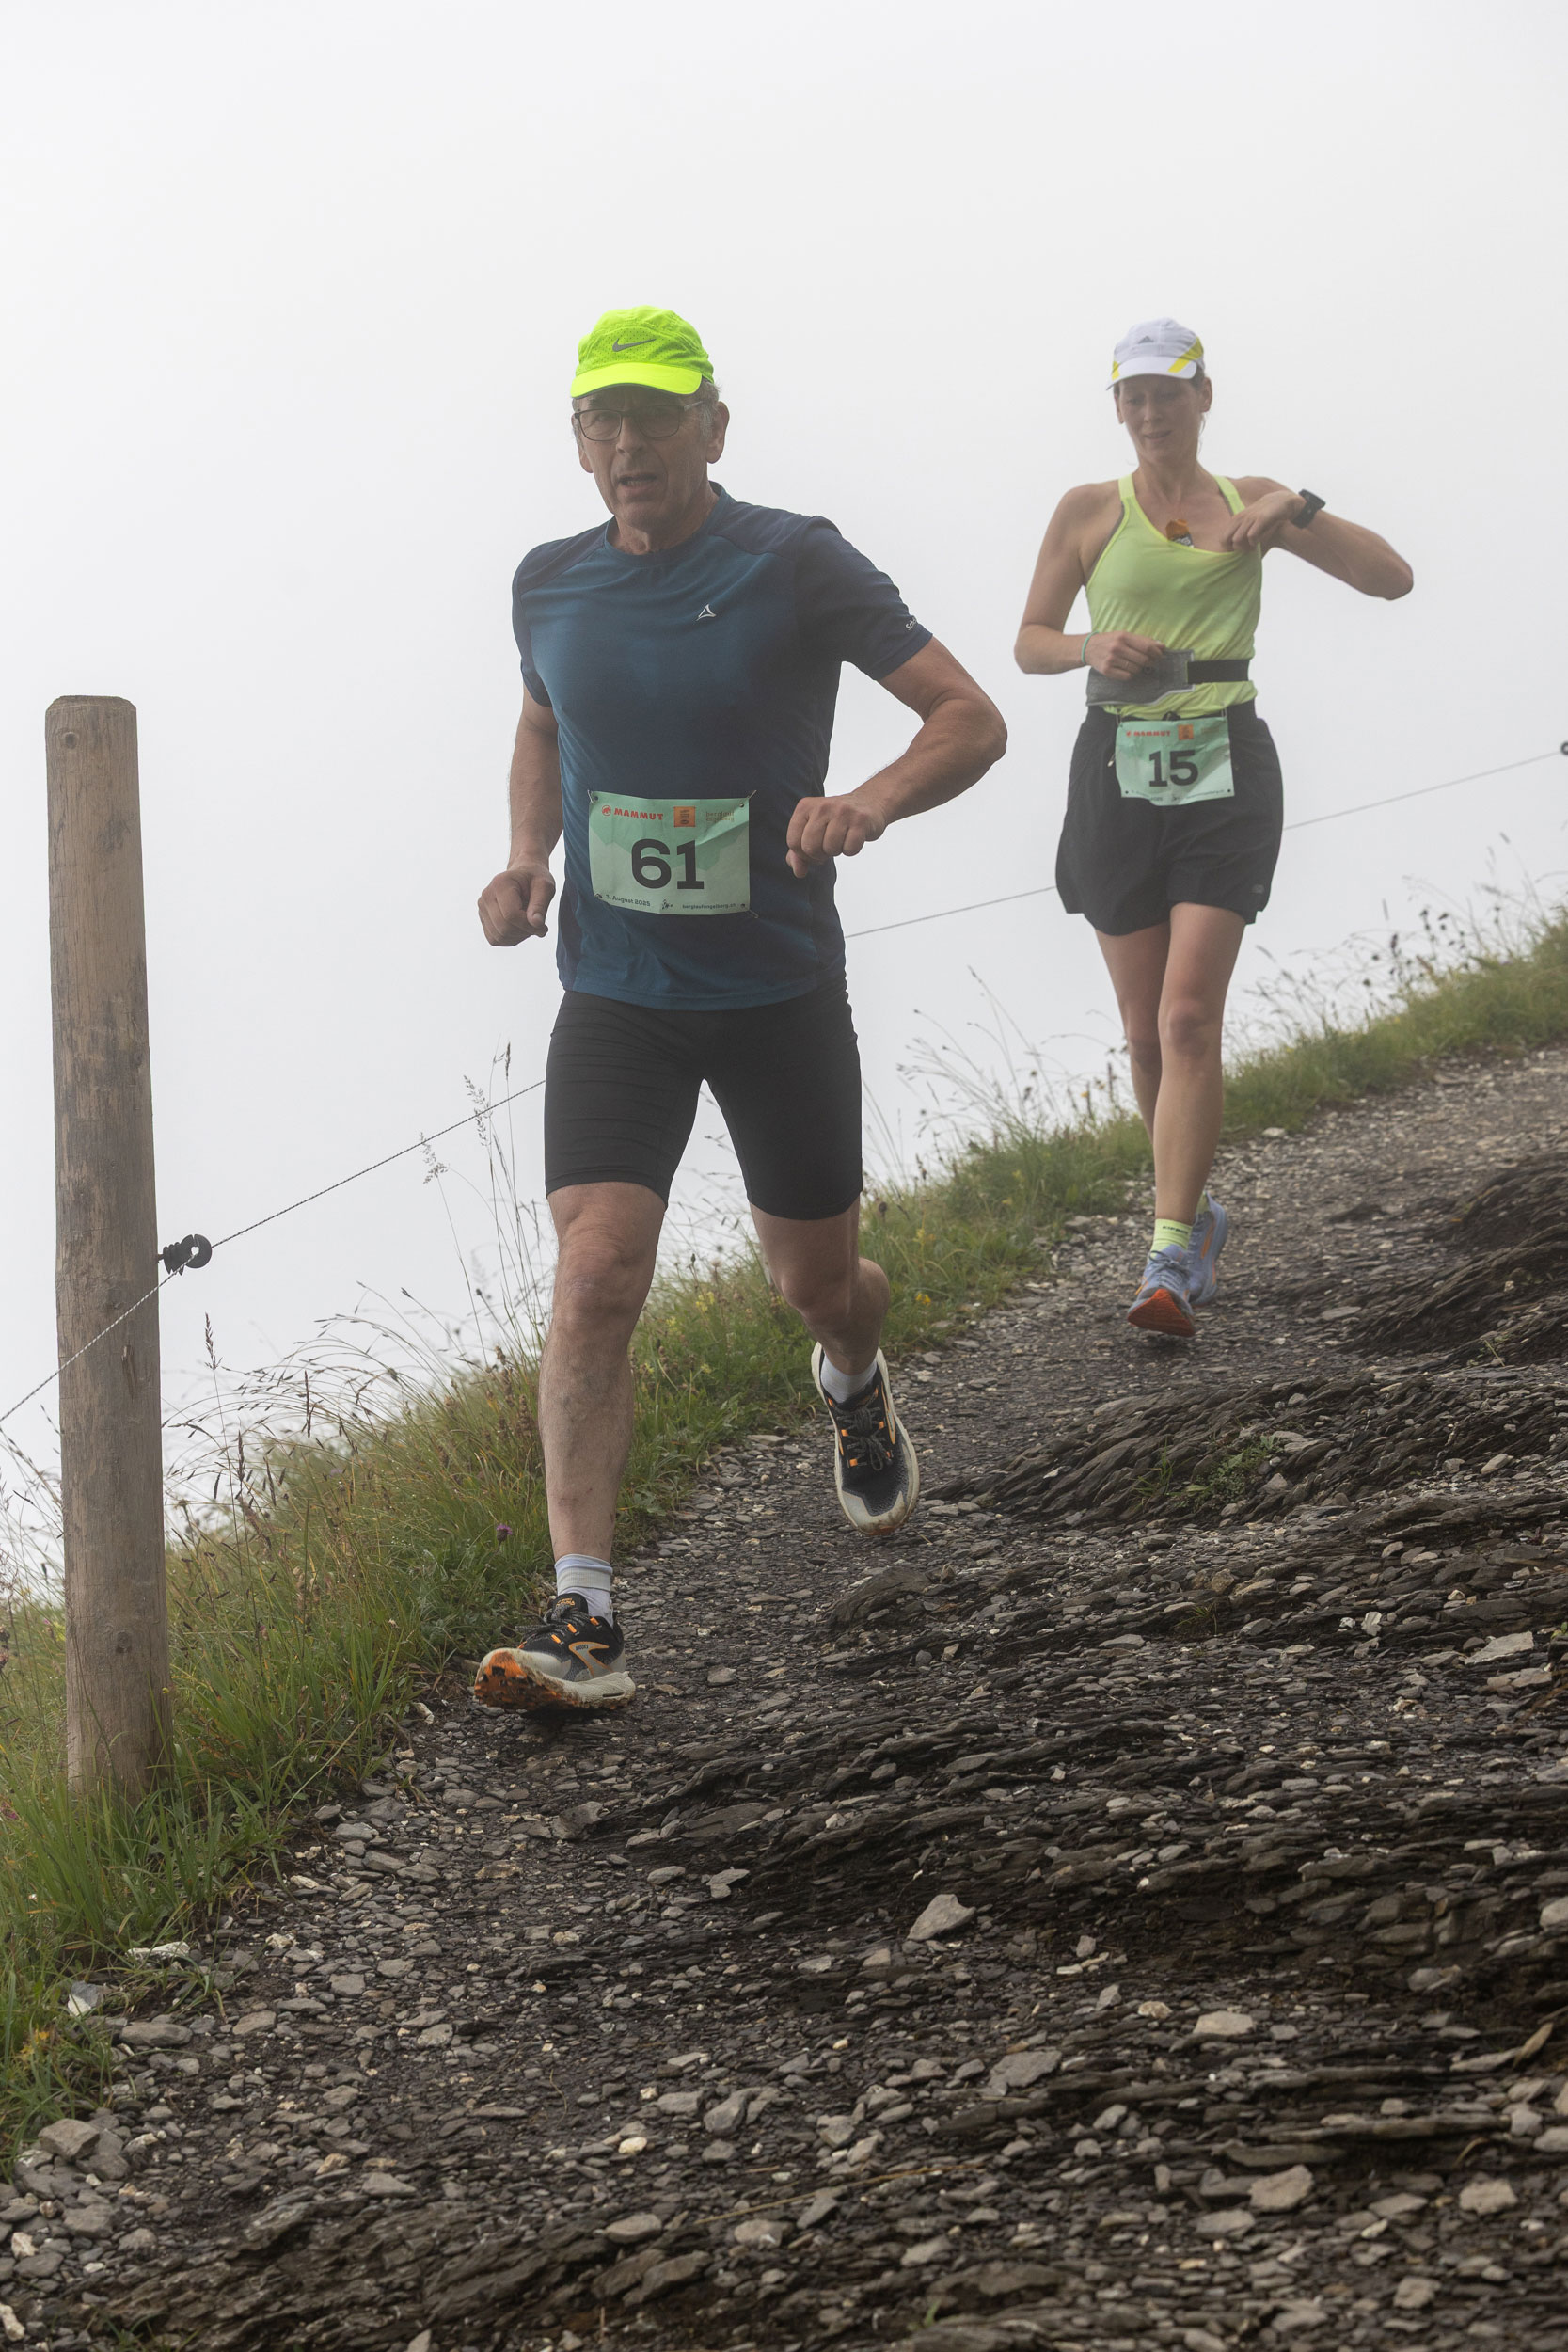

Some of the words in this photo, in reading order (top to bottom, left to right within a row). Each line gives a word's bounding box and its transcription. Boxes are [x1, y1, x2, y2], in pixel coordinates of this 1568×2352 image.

[1149, 750, 1198, 787] 15
[614, 808, 664, 820] MAMMUT
[631, 838, 705, 890] 61
[612, 895, 634, 904] August
[634, 898, 651, 907] 2025
